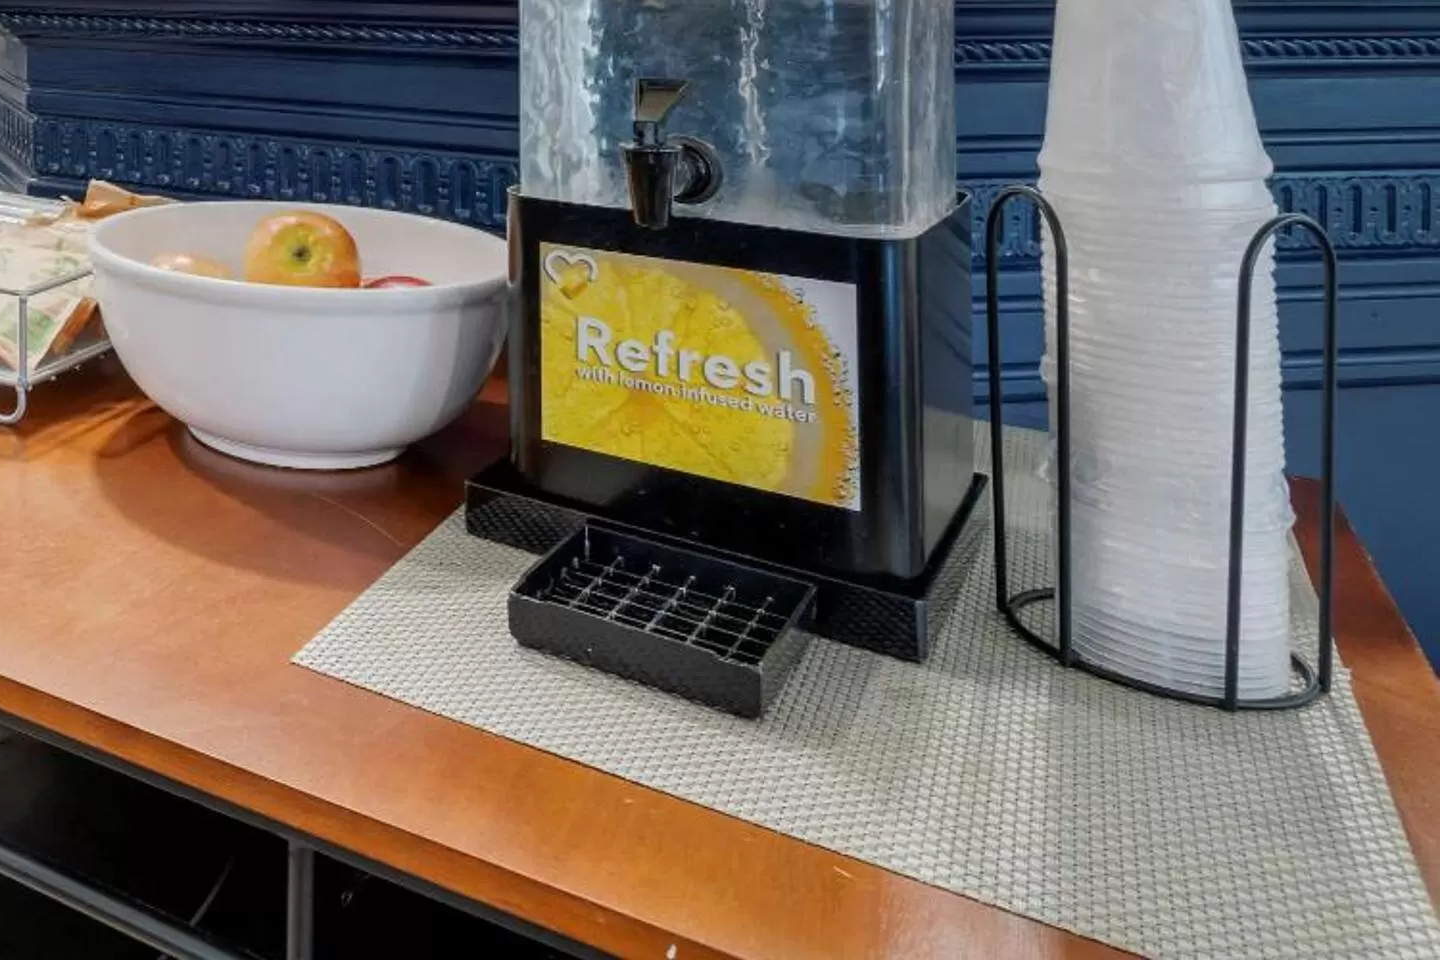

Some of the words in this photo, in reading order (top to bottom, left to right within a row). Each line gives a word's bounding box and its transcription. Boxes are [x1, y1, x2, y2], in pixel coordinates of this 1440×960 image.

[575, 314, 816, 406] Refresh
[577, 365, 612, 385] with
[756, 401, 817, 425] water
